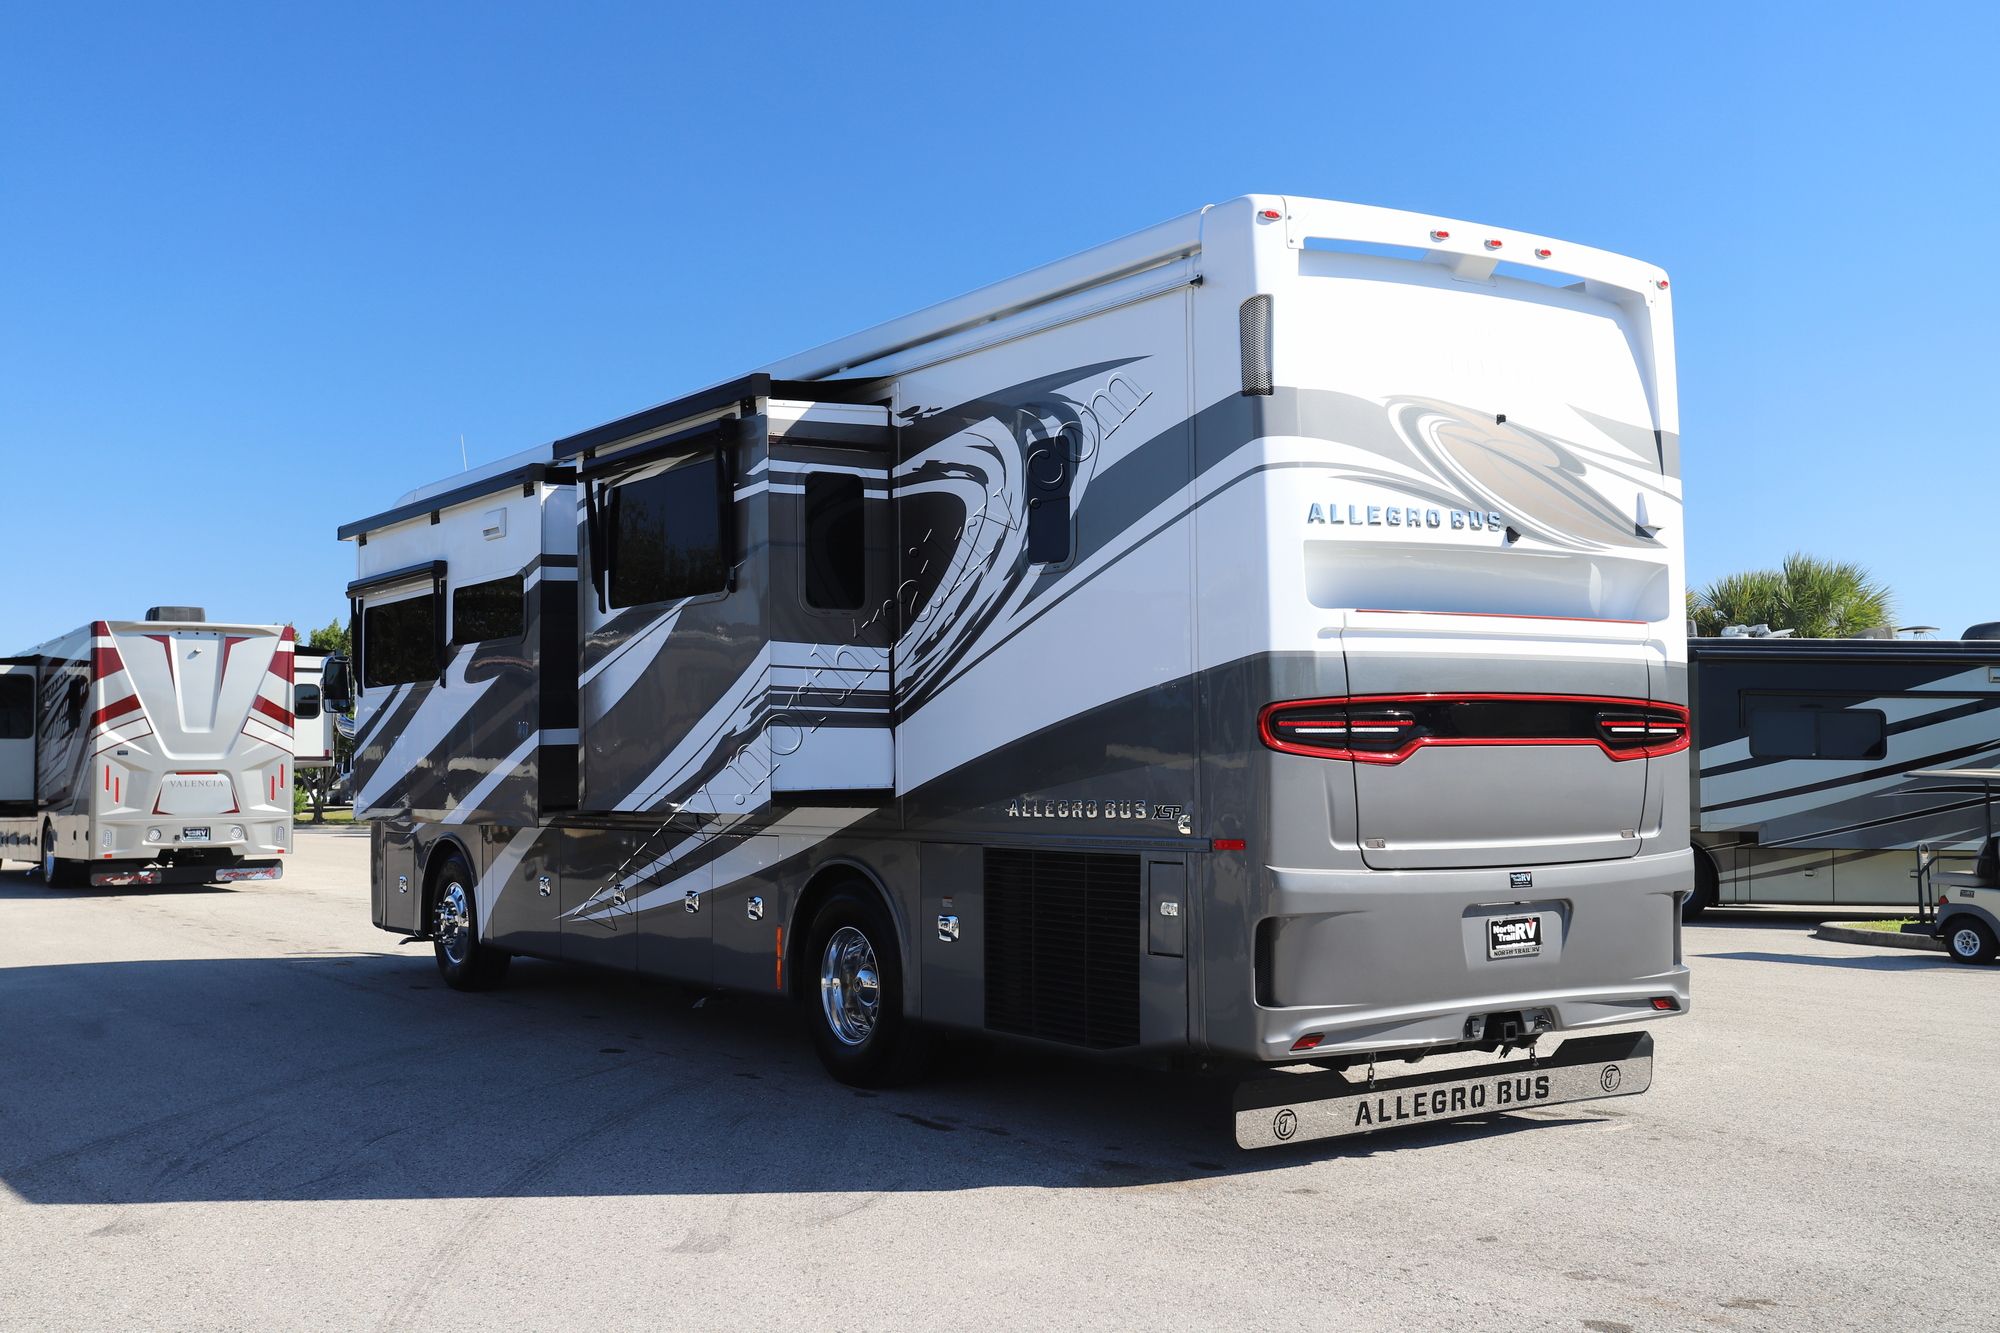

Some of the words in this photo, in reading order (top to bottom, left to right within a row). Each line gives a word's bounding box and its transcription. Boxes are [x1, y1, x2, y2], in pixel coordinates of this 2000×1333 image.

[1307, 502, 1441, 528] ALLEGRO
[1450, 509, 1501, 532] BUS
[170, 779, 224, 788] VALENCIA
[1005, 799, 1098, 819] ALLEGRO
[1104, 799, 1147, 819] BUS
[1152, 804, 1182, 820] XSP
[1493, 925, 1515, 934] North
[1515, 922, 1536, 940] RV
[1497, 933, 1515, 942] Trail
[1494, 948, 1513, 957] NORTH
[1355, 1084, 1486, 1126] ALLEGRO
[1497, 1075, 1550, 1104] BUS
